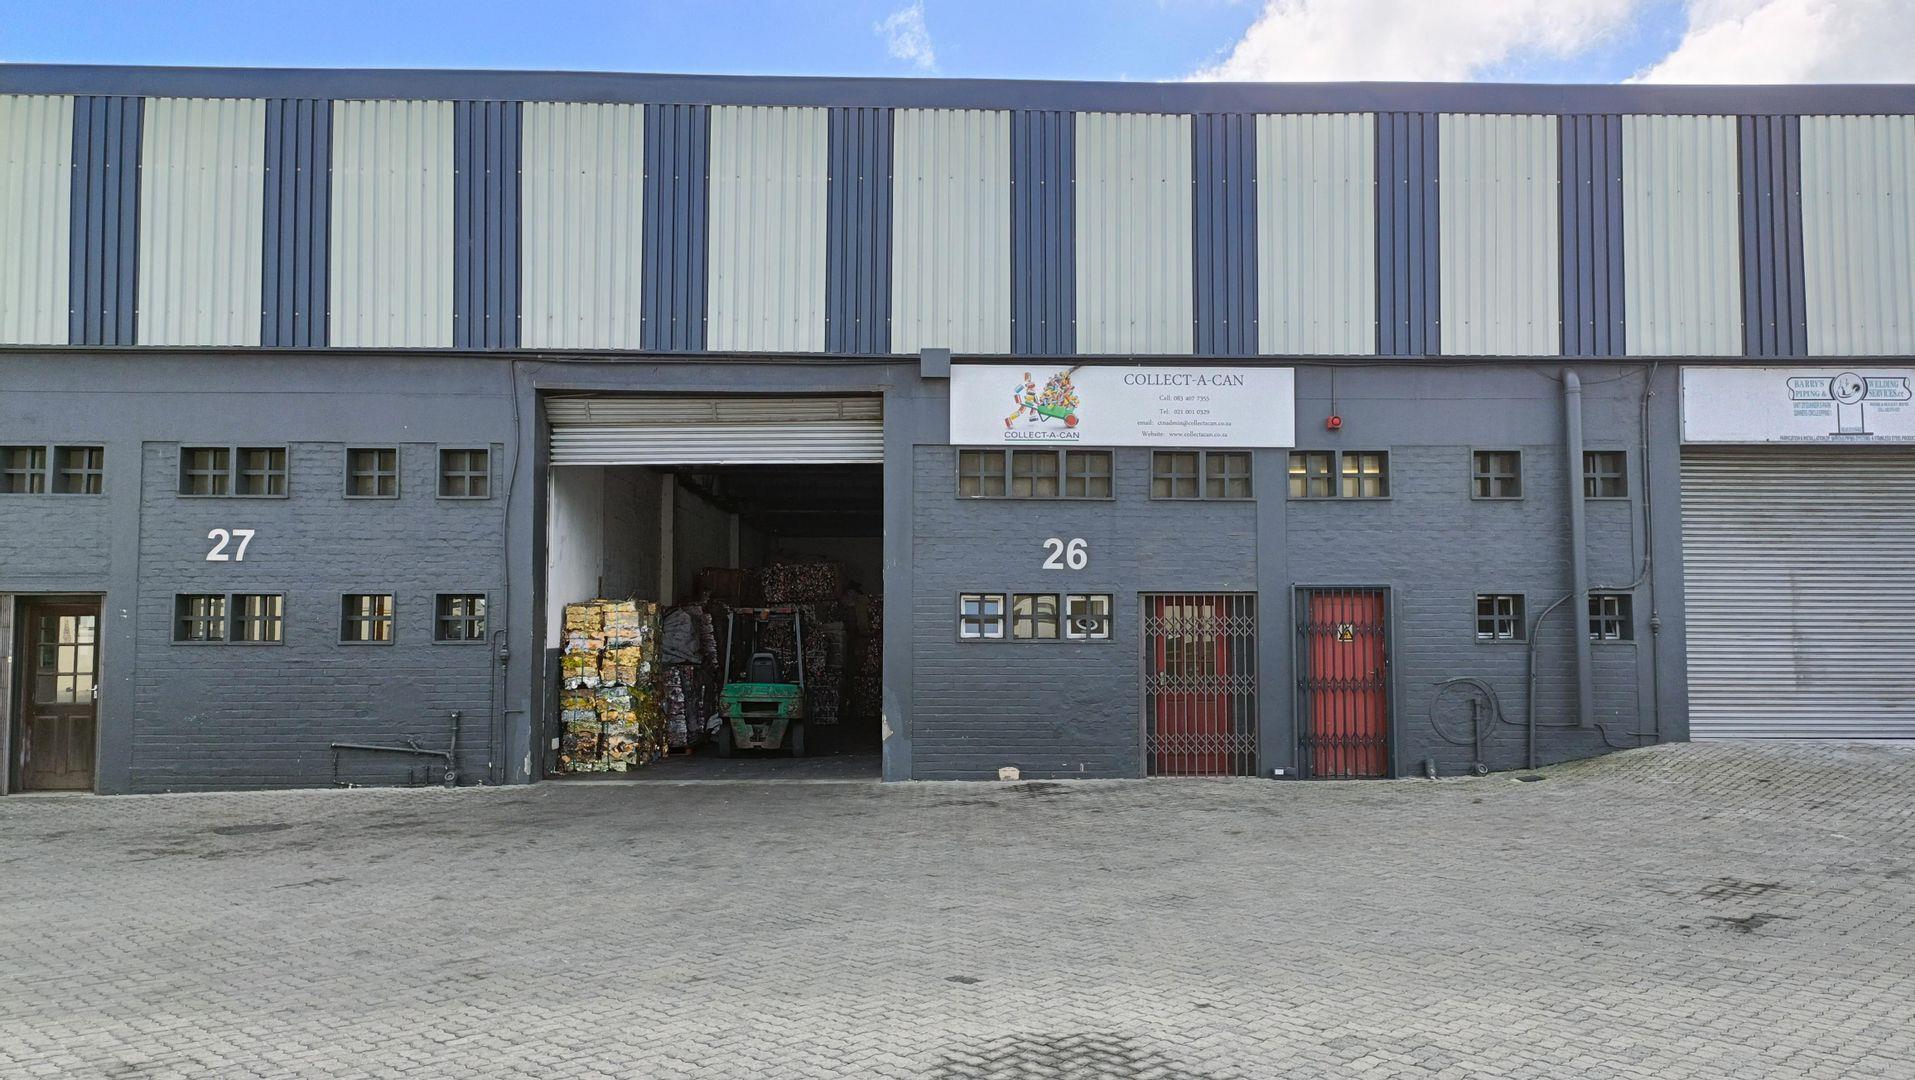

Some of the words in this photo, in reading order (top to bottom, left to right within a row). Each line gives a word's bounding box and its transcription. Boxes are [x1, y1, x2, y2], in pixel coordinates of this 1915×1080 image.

[1123, 373, 1245, 387] COLLECT-A-CAN
[1868, 379, 1899, 388] WELDING
[1795, 389, 1820, 398] PIPING
[1004, 431, 1080, 439] COLLECT-A-CAN
[206, 528, 255, 561] 27
[1042, 537, 1088, 570] 26
